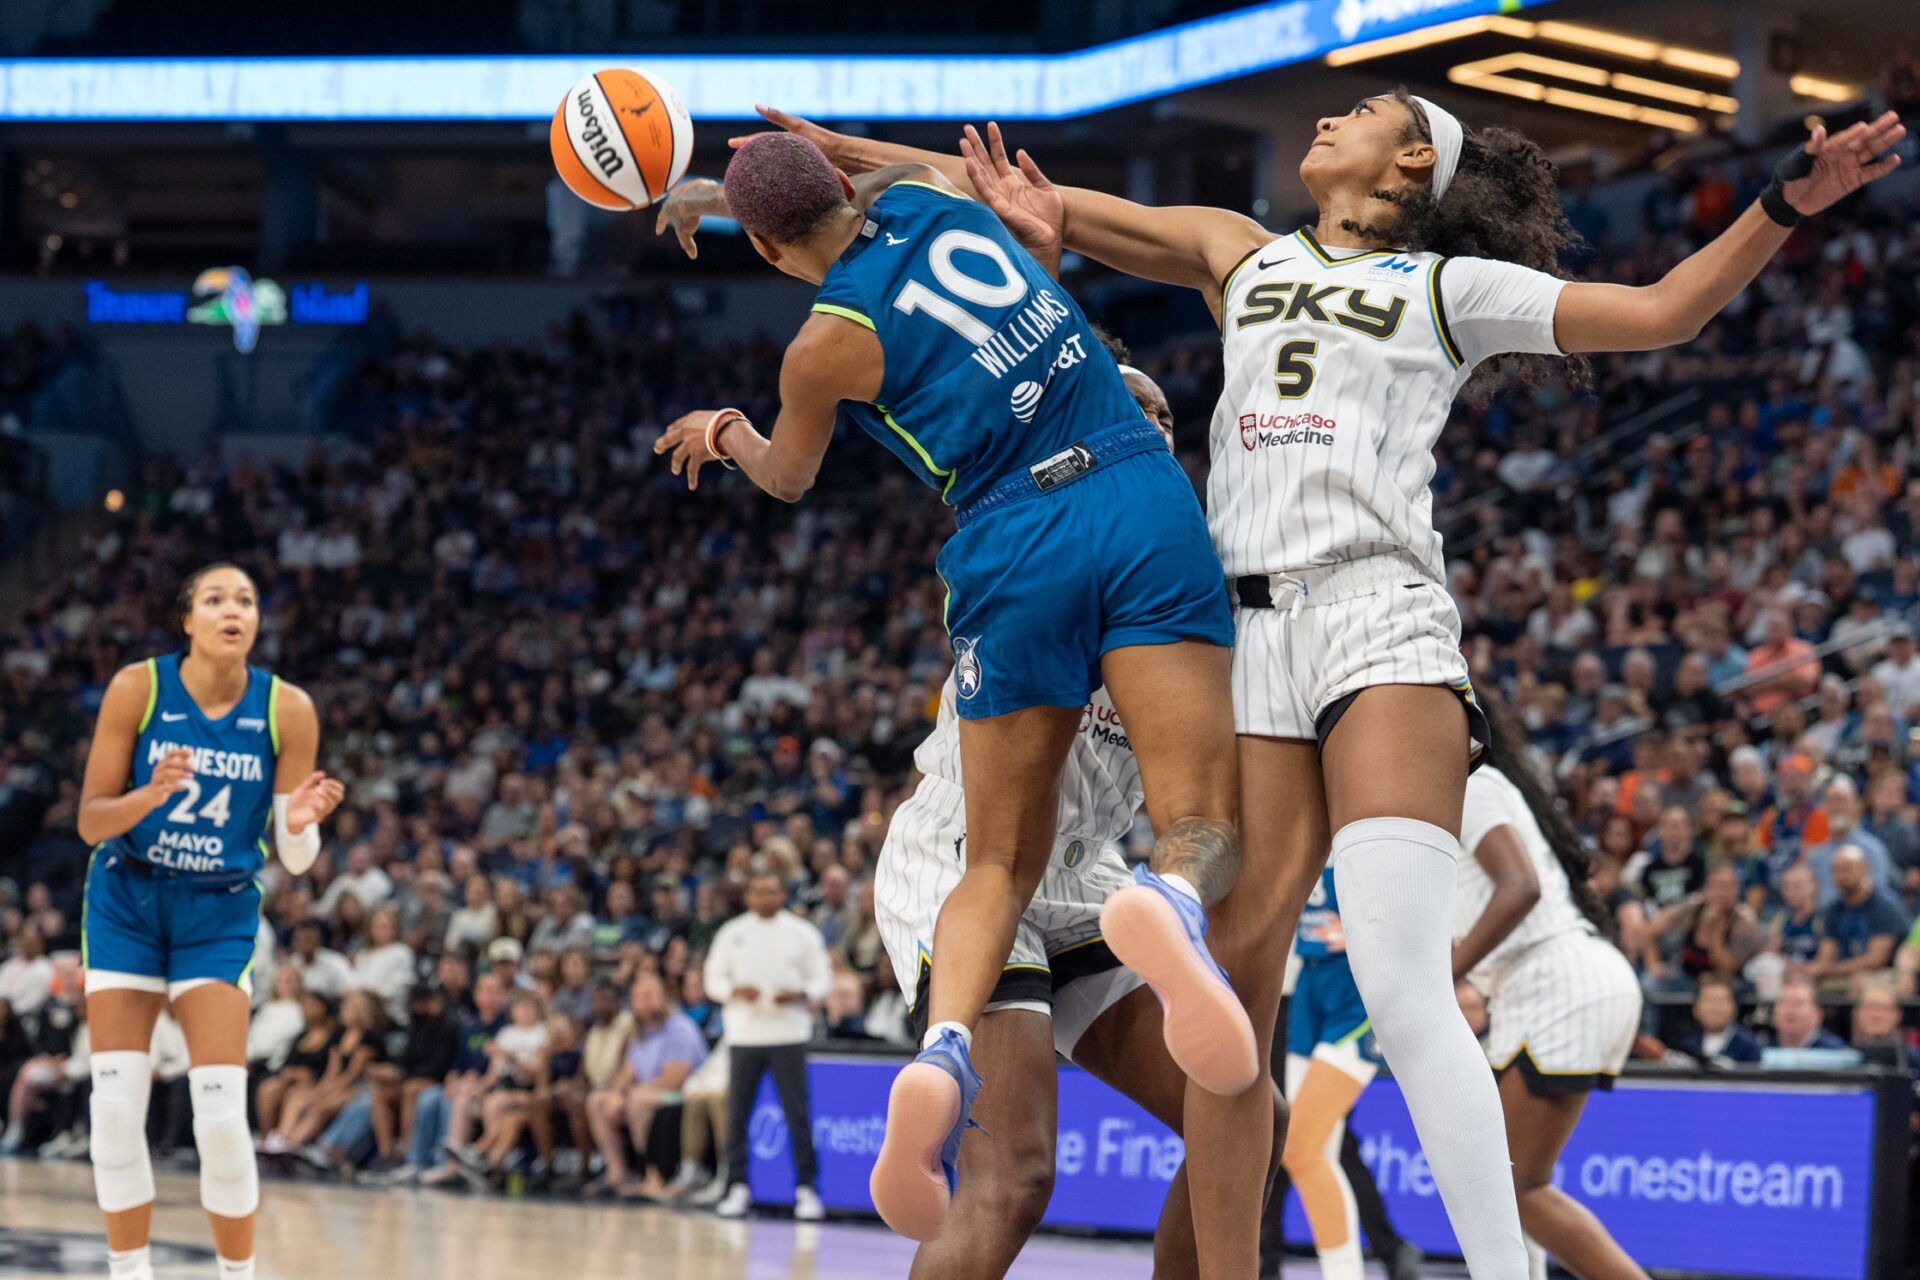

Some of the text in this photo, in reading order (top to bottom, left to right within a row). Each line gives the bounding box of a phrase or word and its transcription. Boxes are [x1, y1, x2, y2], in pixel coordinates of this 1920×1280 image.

[577, 88, 624, 179] Wilson
[893, 229, 1028, 348] 10
[1237, 281, 1409, 341] SKY
[971, 289, 1069, 380] WILLIAMS
[1274, 338, 1320, 401] 5
[1258, 412, 1337, 430] UChicago
[1258, 426, 1335, 449] Medicine
[167, 779, 232, 828] 24
[158, 829, 224, 856] MAYO
[1096, 1117, 1186, 1181] Fina
[1580, 1152, 1844, 1209] onestream
